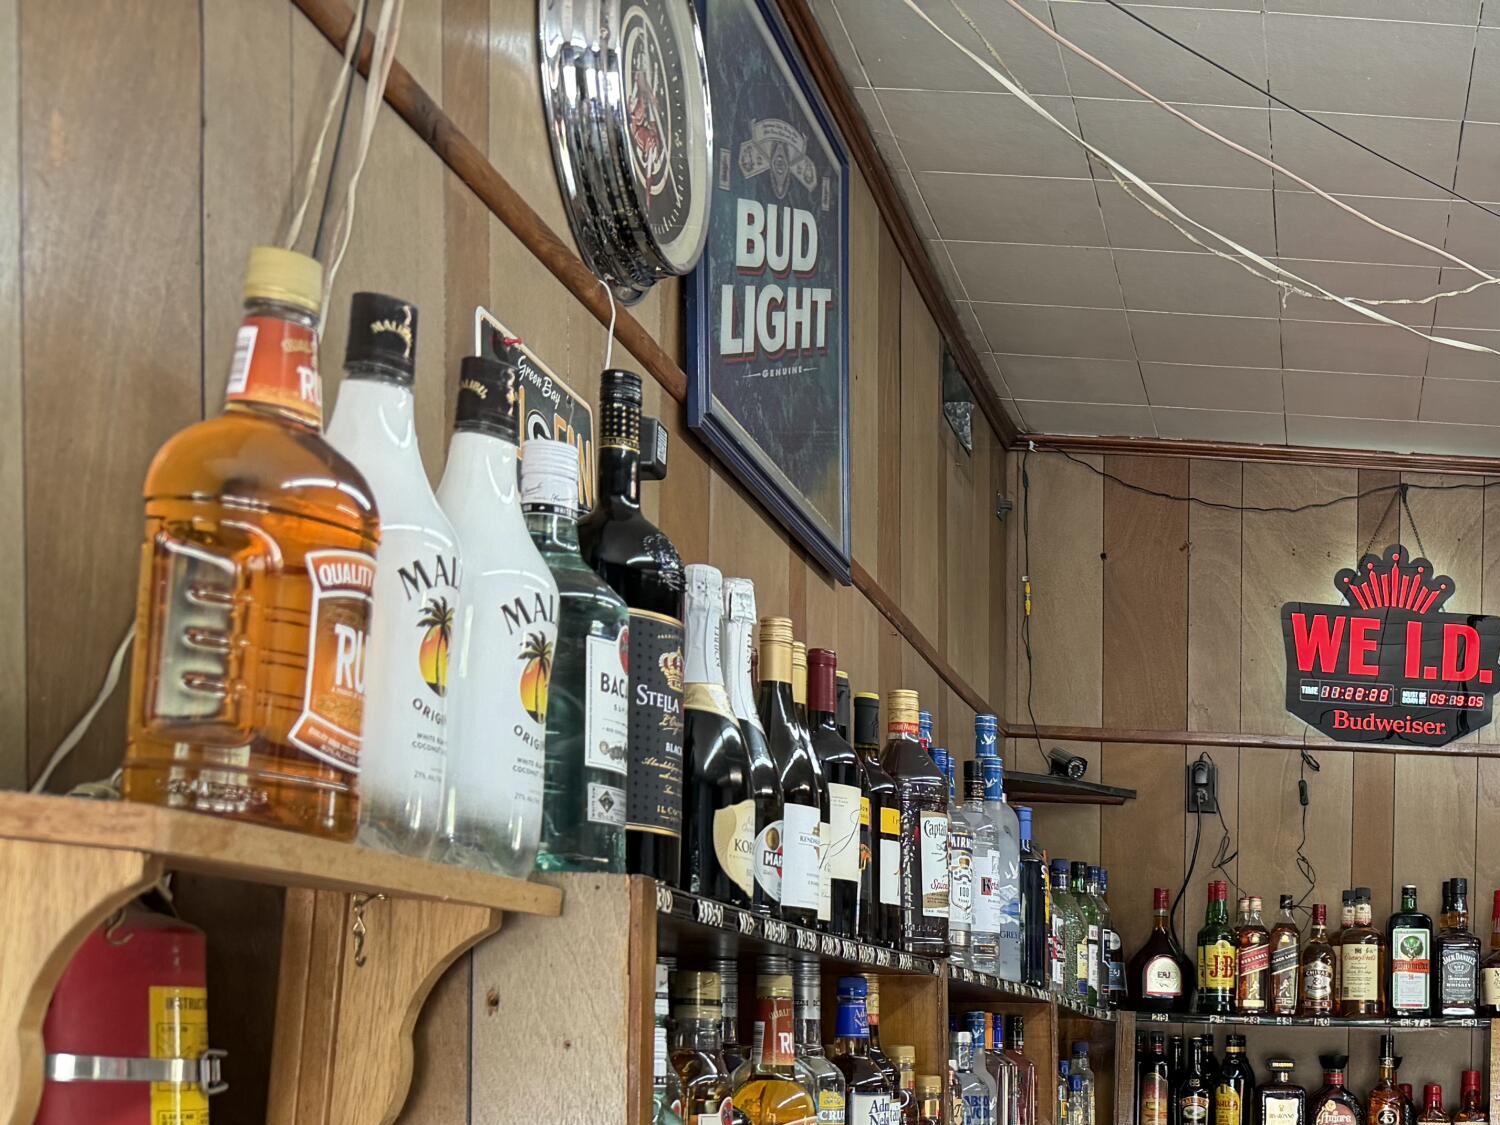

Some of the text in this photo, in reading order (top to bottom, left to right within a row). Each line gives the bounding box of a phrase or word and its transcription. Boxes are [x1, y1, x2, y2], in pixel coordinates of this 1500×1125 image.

[736, 198, 818, 272] BUD
[720, 284, 832, 355] LIGHT
[517, 355, 562, 409] Green Bay
[762, 366, 803, 378] GENUINE
[1291, 613, 1493, 684] WE I.D.
[1301, 685, 1318, 694] TIME
[1333, 709, 1446, 735] Budweiser
